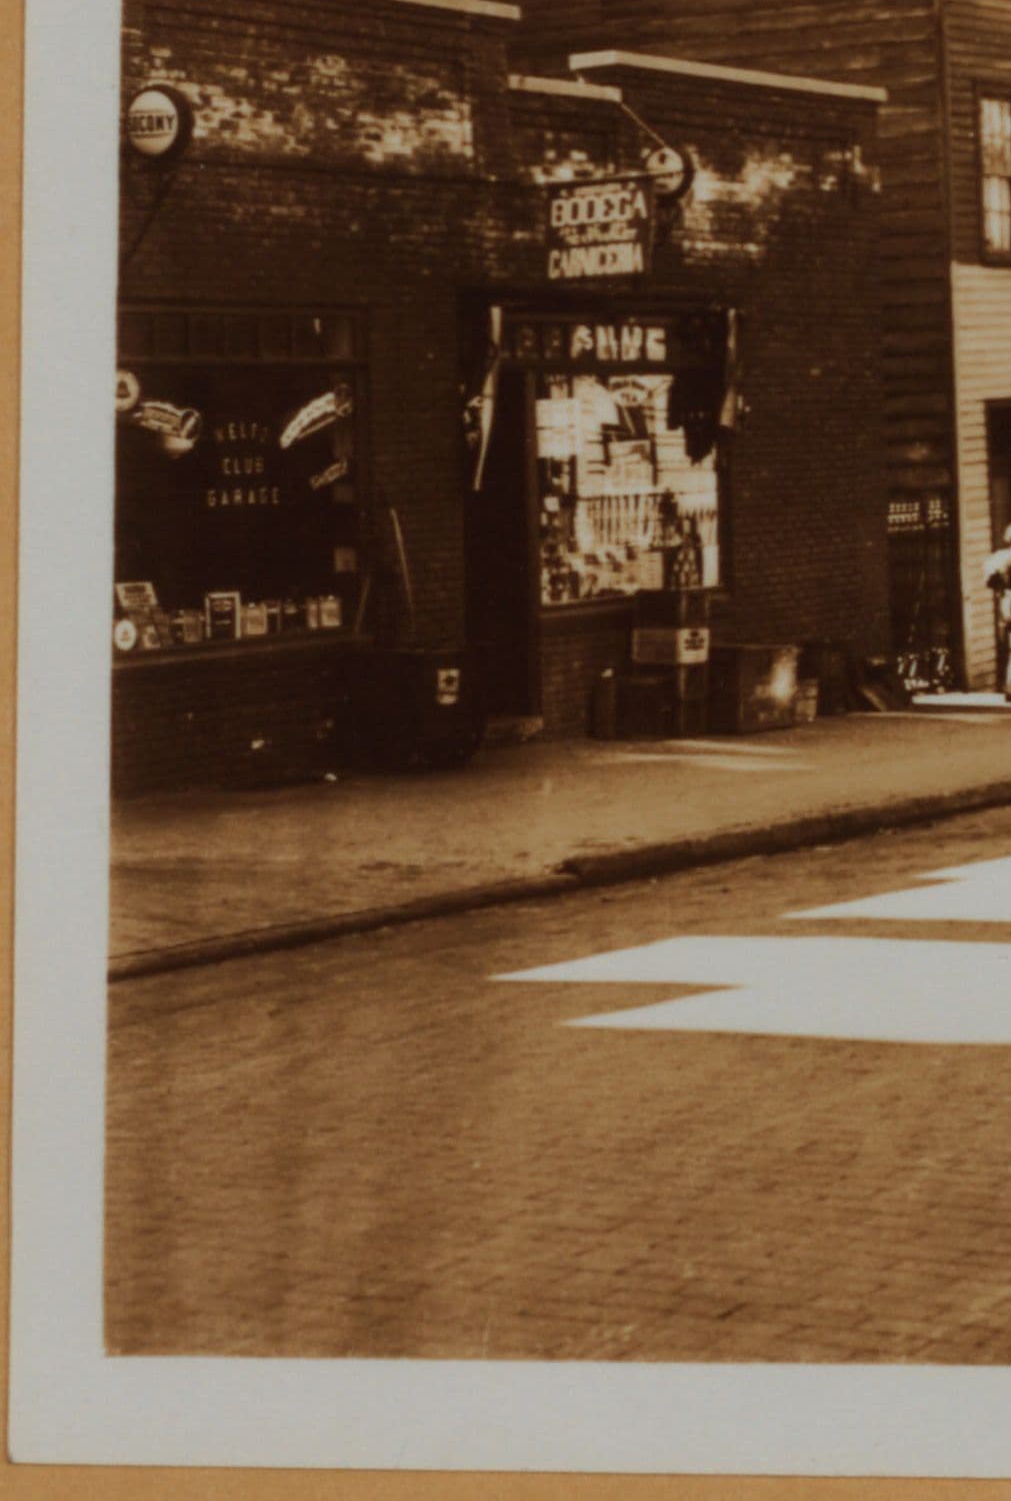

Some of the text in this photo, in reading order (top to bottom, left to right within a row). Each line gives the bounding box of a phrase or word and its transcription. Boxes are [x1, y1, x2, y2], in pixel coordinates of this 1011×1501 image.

[551, 191, 647, 226] BODEGA
[549, 242, 643, 279] CARNICERIA
[223, 456, 265, 475] CLUB
[207, 486, 280, 507] GARAGE
